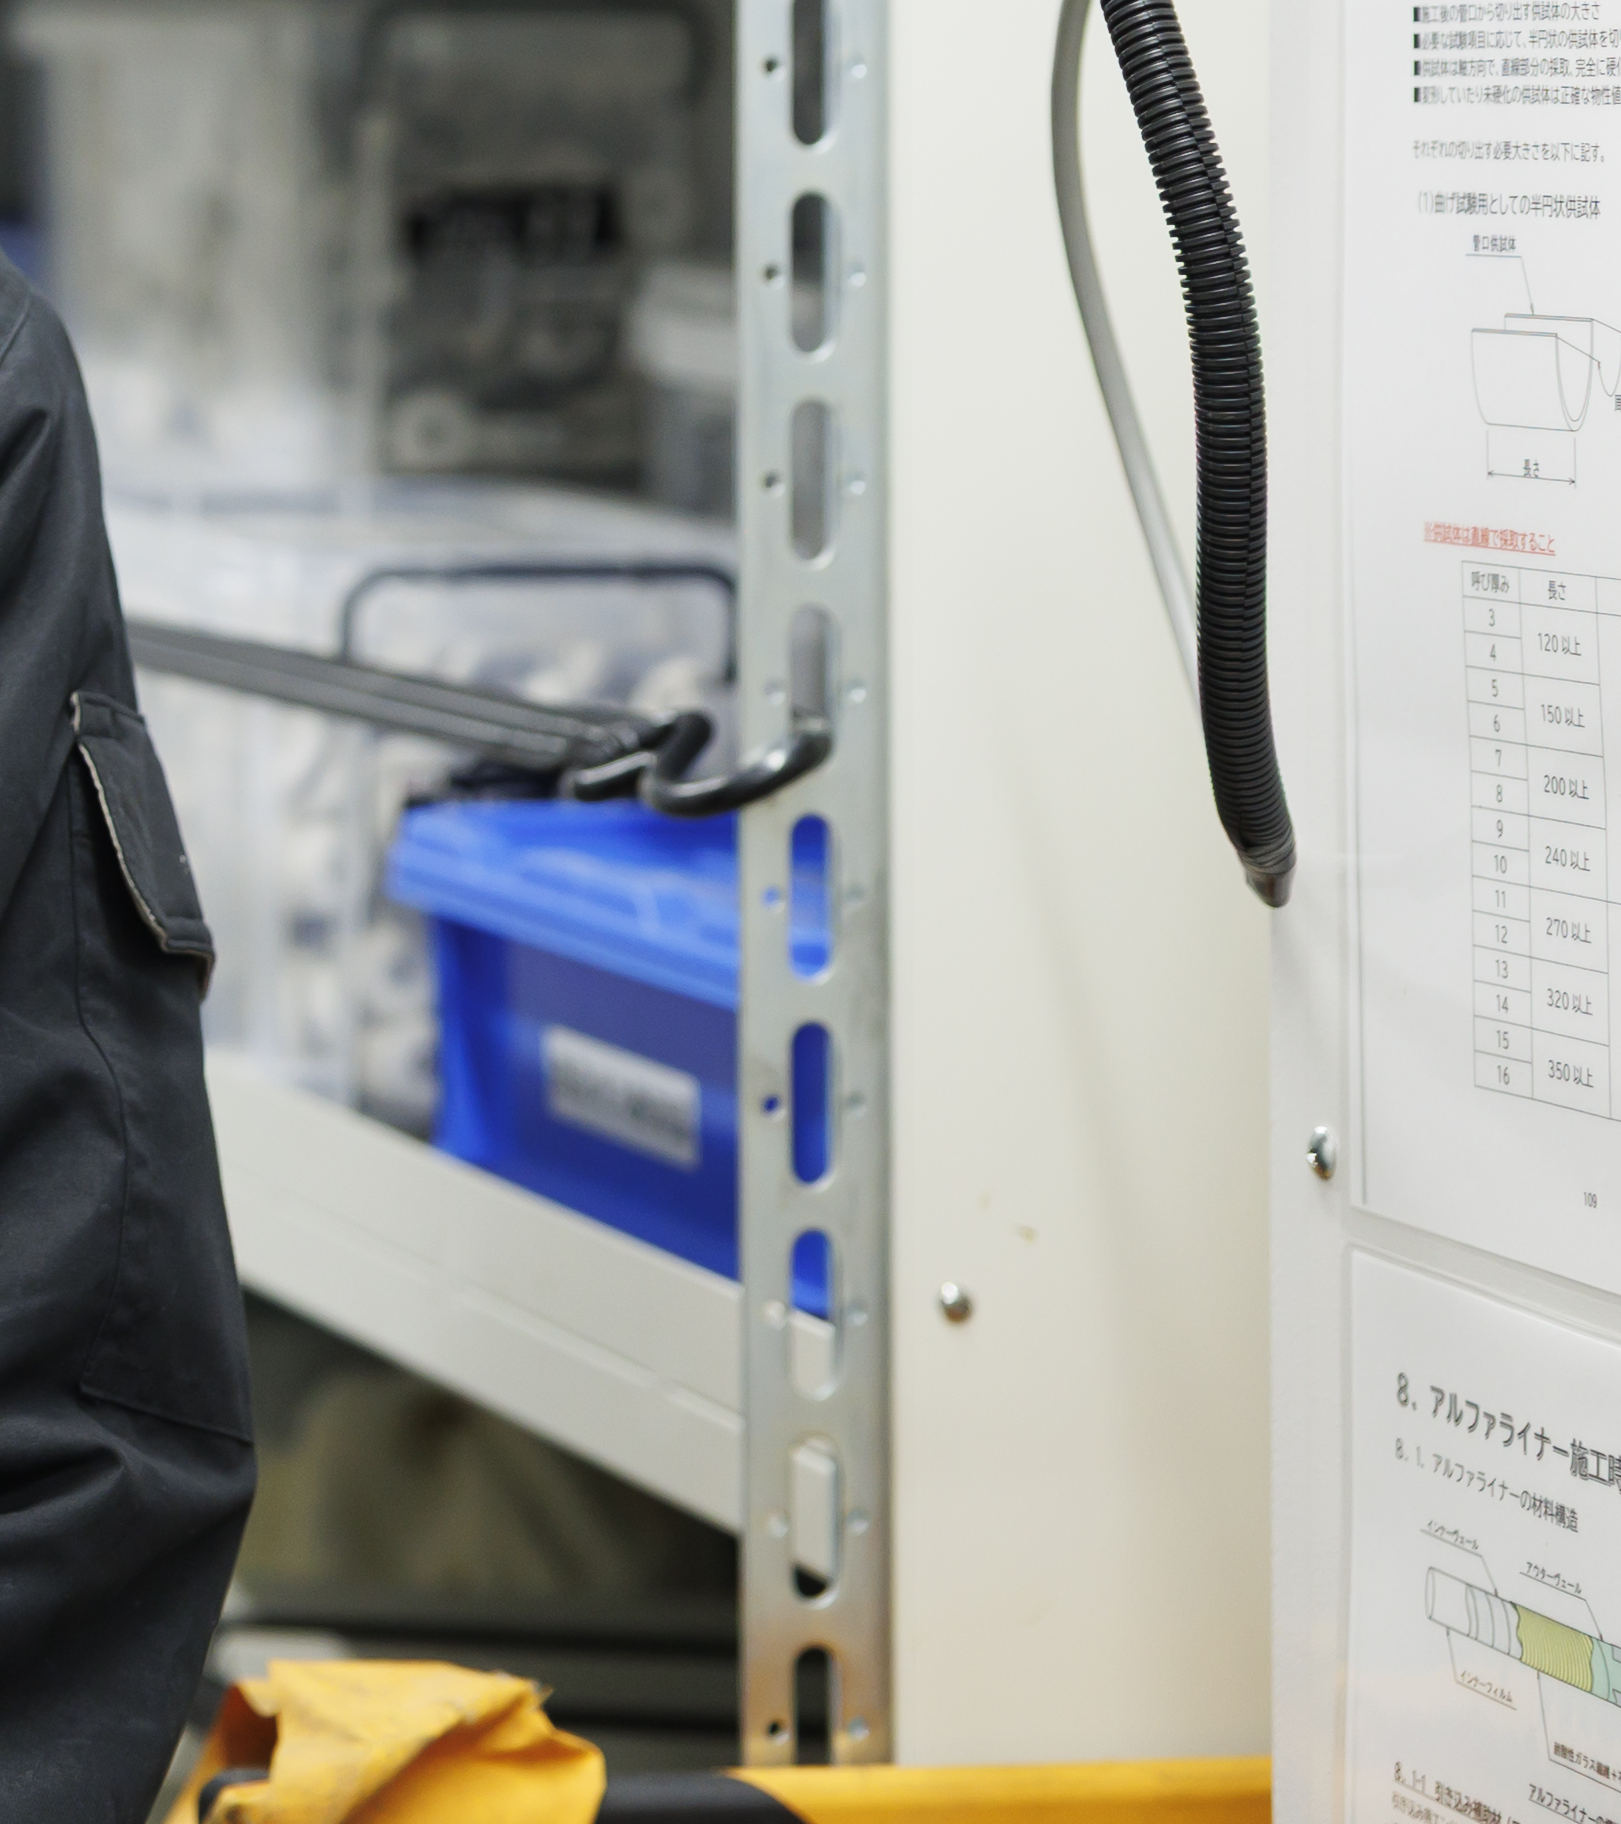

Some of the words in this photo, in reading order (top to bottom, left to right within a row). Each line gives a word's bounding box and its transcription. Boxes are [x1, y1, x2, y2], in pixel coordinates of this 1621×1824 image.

[1523, 459, 1540, 478] 長さ
[1470, 571, 1510, 594] 呼び厚み
[1547, 580, 1567, 602] 長さ
[1488, 608, 1495, 627] 3
[1489, 644, 1497, 662] 4
[1491, 679, 1499, 698] 5
[1493, 714, 1501, 733] 6
[1495, 749, 1502, 767] 7
[1496, 784, 1503, 803] 8
[1496, 819, 1504, 838] 9
[1494, 854, 1507, 874] 10
[1495, 889, 1506, 908] 11
[1495, 924, 1508, 944] 12
[1495, 959, 1508, 979] 13
[1496, 994, 1509, 1014] 14
[1496, 1030, 1509, 1050] 15
[1497, 1065, 1510, 1086] 16
[1583, 1191, 1598, 1209] 109
